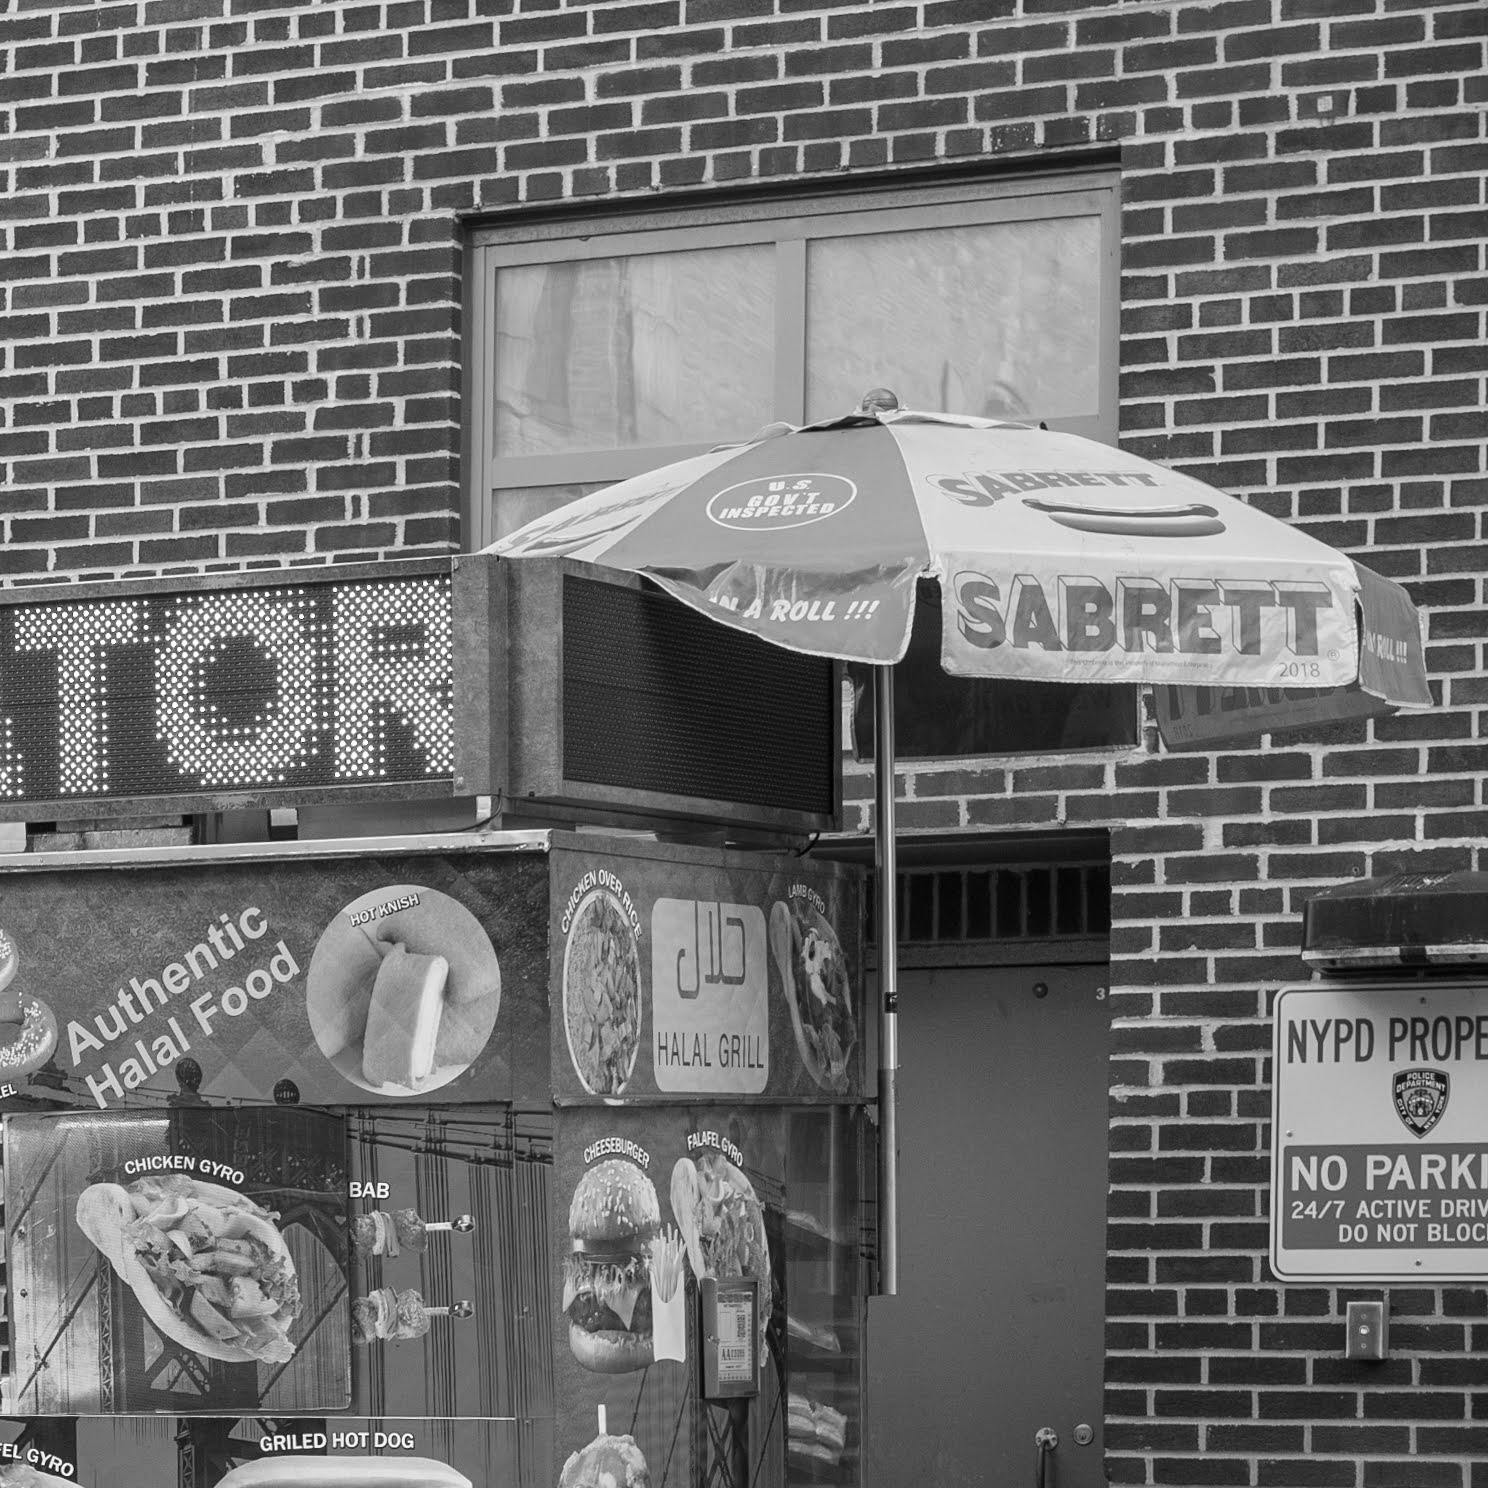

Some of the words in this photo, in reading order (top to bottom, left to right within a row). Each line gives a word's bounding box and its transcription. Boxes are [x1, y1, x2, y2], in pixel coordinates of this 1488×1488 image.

[748, 491, 821, 508] GOV'T
[926, 470, 1162, 507] SABRETT
[719, 502, 835, 519] INSPECTED
[743, 600, 762, 619] A
[769, 600, 836, 622] ROLL
[953, 570, 1333, 656] SABRETT
[1279, 662, 1321, 678] 2018
[350, 908, 379, 927] HOT
[379, 893, 420, 920] KNISH
[561, 869, 597, 934] CHICKEN
[598, 869, 622, 898] OVER
[622, 891, 642, 941] RICE
[788, 884, 807, 898] LAMB
[807, 888, 825, 914] GYRO
[66, 906, 268, 1068] Authentic
[84, 1015, 191, 1110] Halal
[189, 939, 301, 1037] Food
[658, 1033, 711, 1068] HALAL
[719, 1033, 764, 1068] GRILL
[1288, 1018, 1374, 1064] NYPD
[1389, 1016, 1488, 1061] PROPE
[1396, 1080, 1446, 1093] DEPARTMENT
[1407, 1072, 1435, 1080] POLICE
[1397, 1098, 1407, 1115] CITY
[584, 1137, 650, 1169] CHEESEBURGER
[687, 1131, 720, 1150] FALAFEL
[721, 1137, 743, 1167] GYRO
[123, 1155, 196, 1176] CHICKEN
[198, 1157, 245, 1185] GYRO
[1291, 1155, 1348, 1191] NO
[1366, 1154, 1488, 1190] PARKI
[348, 1181, 390, 1200] BAB
[1291, 1200, 1345, 1219] 24/7
[1356, 1199, 1431, 1218] ACTIVE
[1440, 1199, 1488, 1218] DRIV
[1339, 1224, 1368, 1242] DO
[1377, 1223, 1418, 1242] NOT
[1427, 1223, 1488, 1242] BLOC
[259, 1433, 327, 1452] GRILED
[332, 1433, 368, 1451] HOT
[371, 1432, 415, 1450] DOG
[26, 1446, 75, 1478] GYRO
